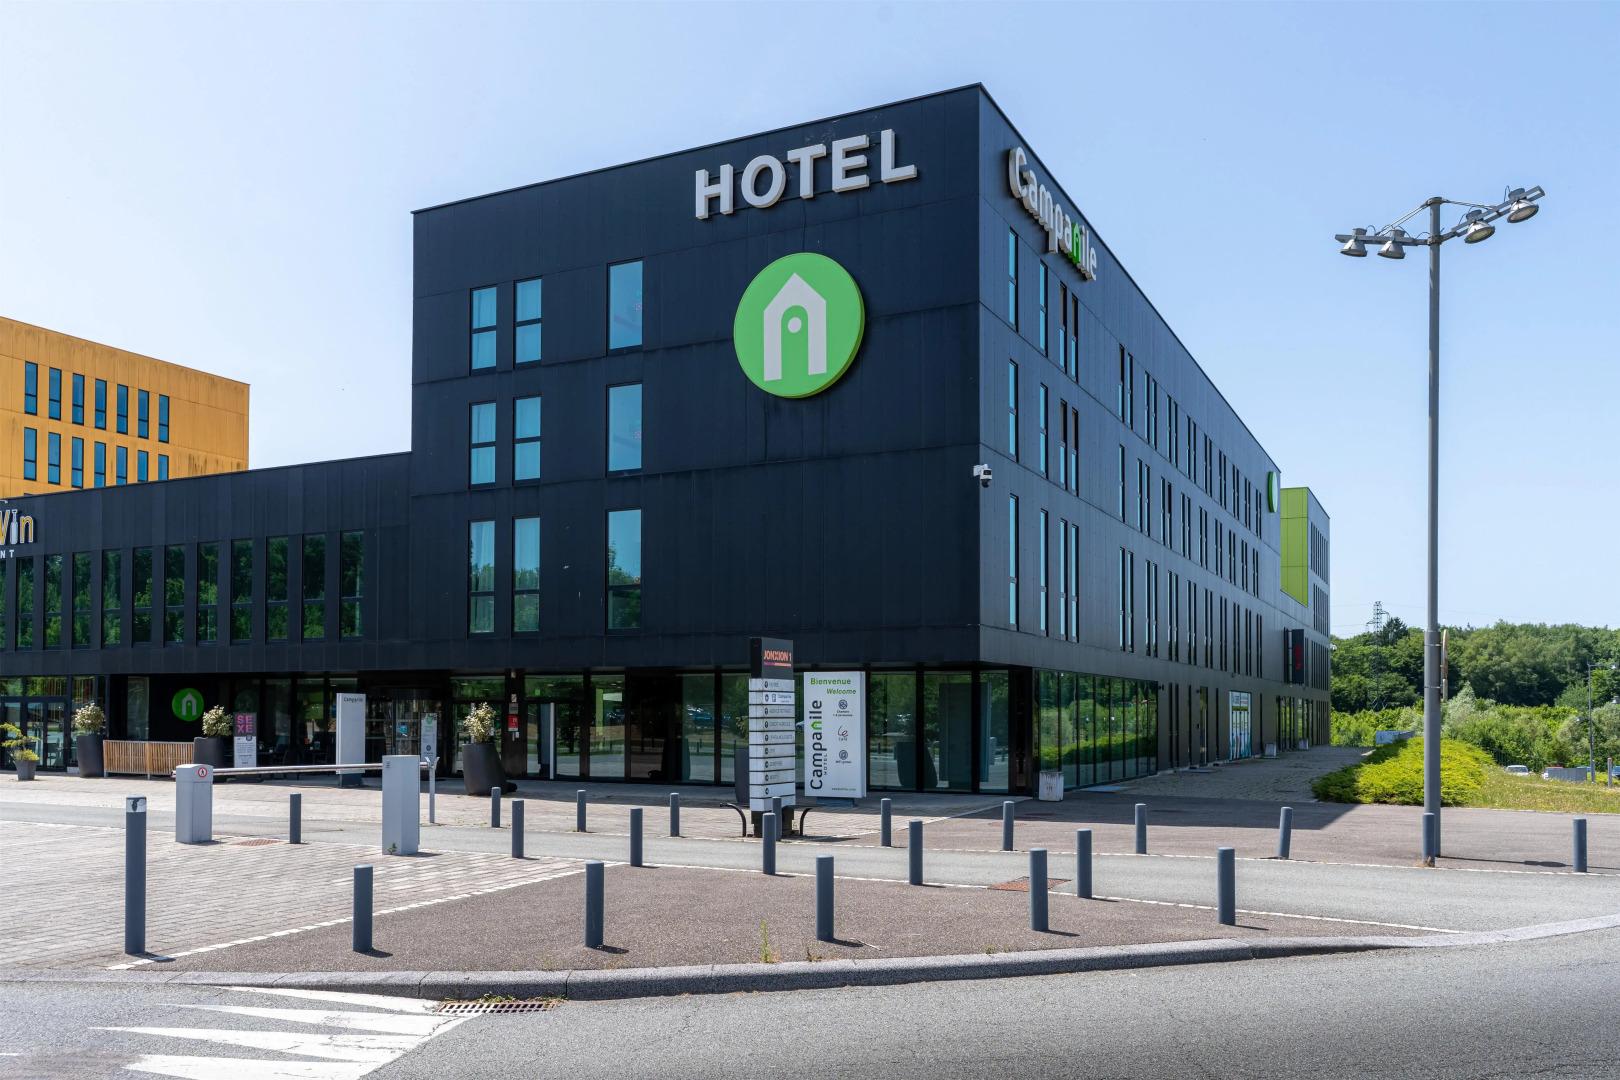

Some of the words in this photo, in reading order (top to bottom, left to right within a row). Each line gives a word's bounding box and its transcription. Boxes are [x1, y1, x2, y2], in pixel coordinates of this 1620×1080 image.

[695, 129, 918, 220] HOTEL
[1008, 146, 1097, 281] Campanile
[810, 678, 852, 686] Bienvenue
[237, 715, 253, 724] SE
[237, 724, 253, 734] XE
[809, 700, 827, 790] Campanile
